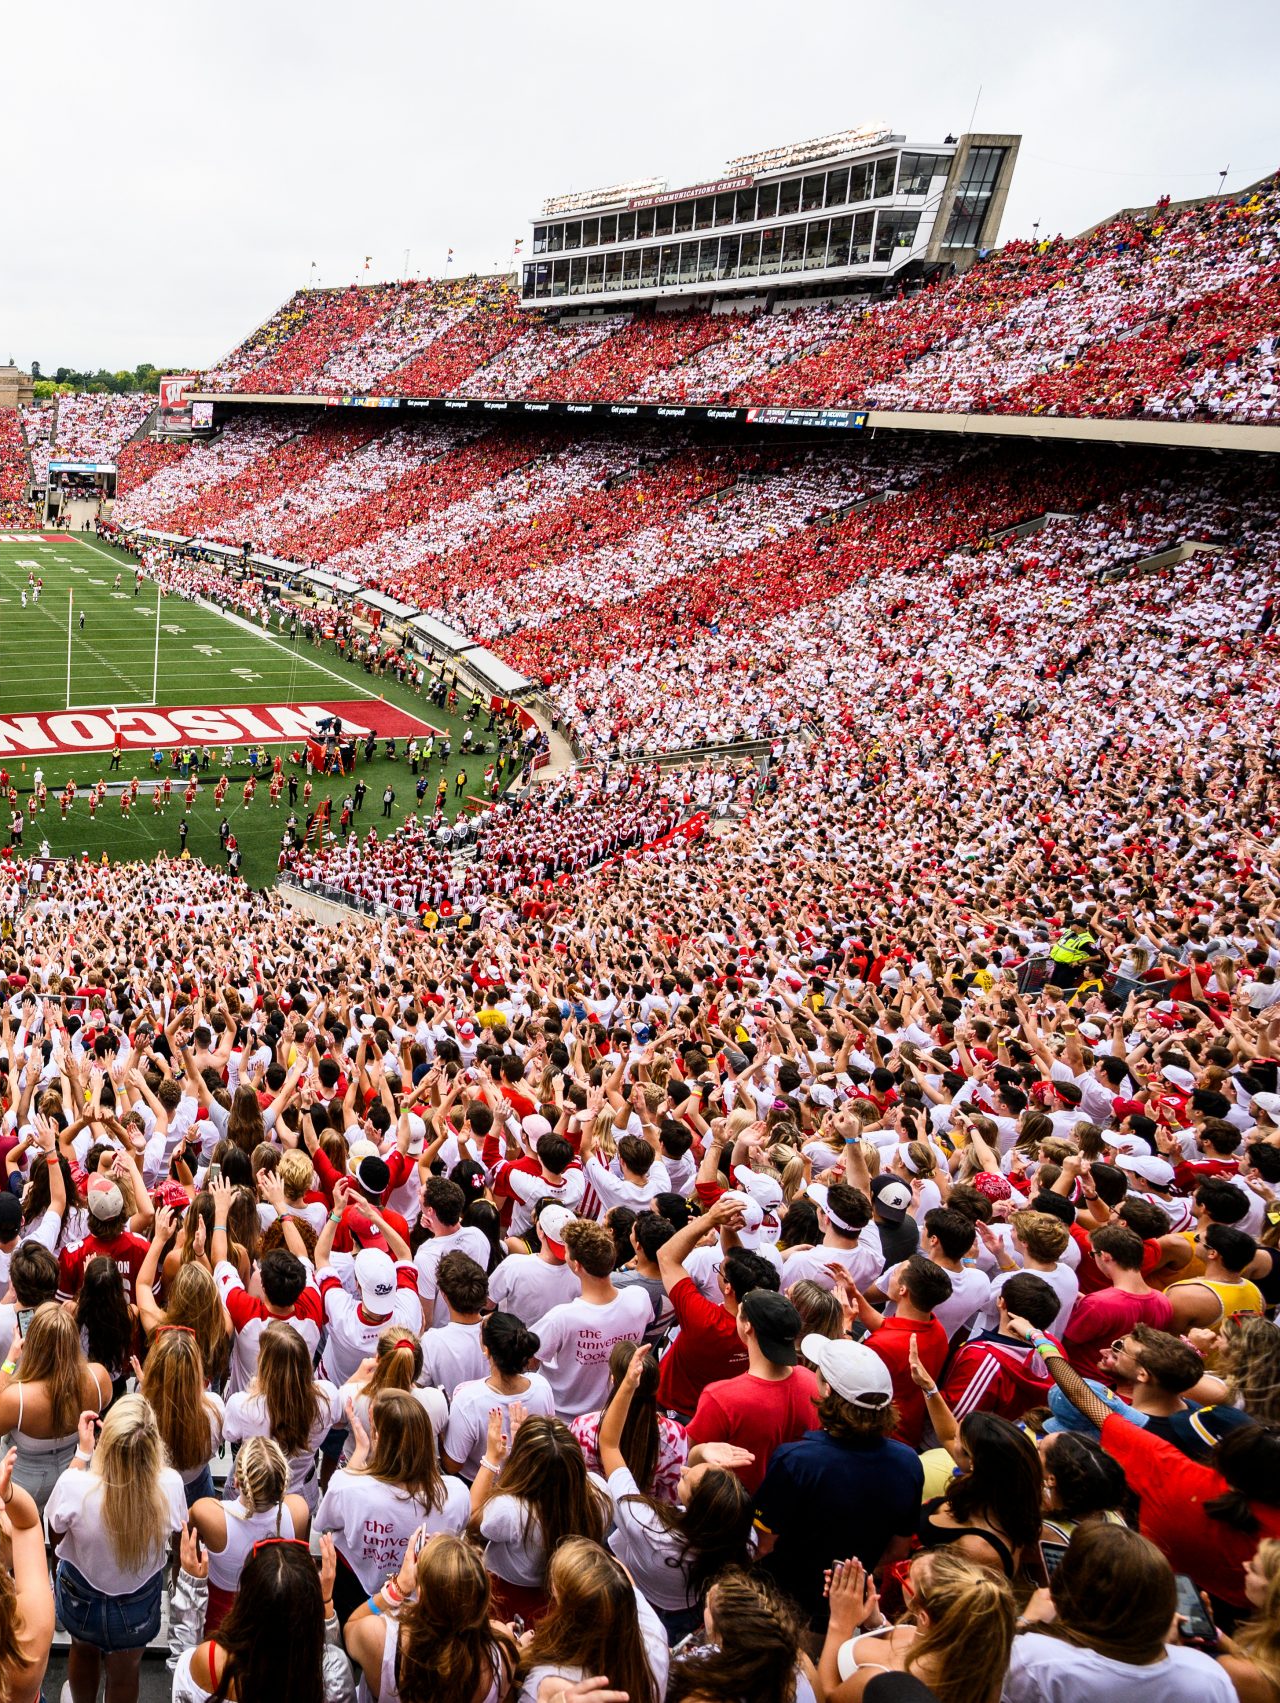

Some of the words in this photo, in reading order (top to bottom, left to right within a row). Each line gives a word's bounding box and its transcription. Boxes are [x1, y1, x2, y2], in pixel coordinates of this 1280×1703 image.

[654, 186, 716, 205] COMMUNICATIONS
[717, 179, 747, 193] CENTER
[658, 407, 666, 415] Get
[707, 409, 716, 417] Get
[229, 667, 264, 683] 10
